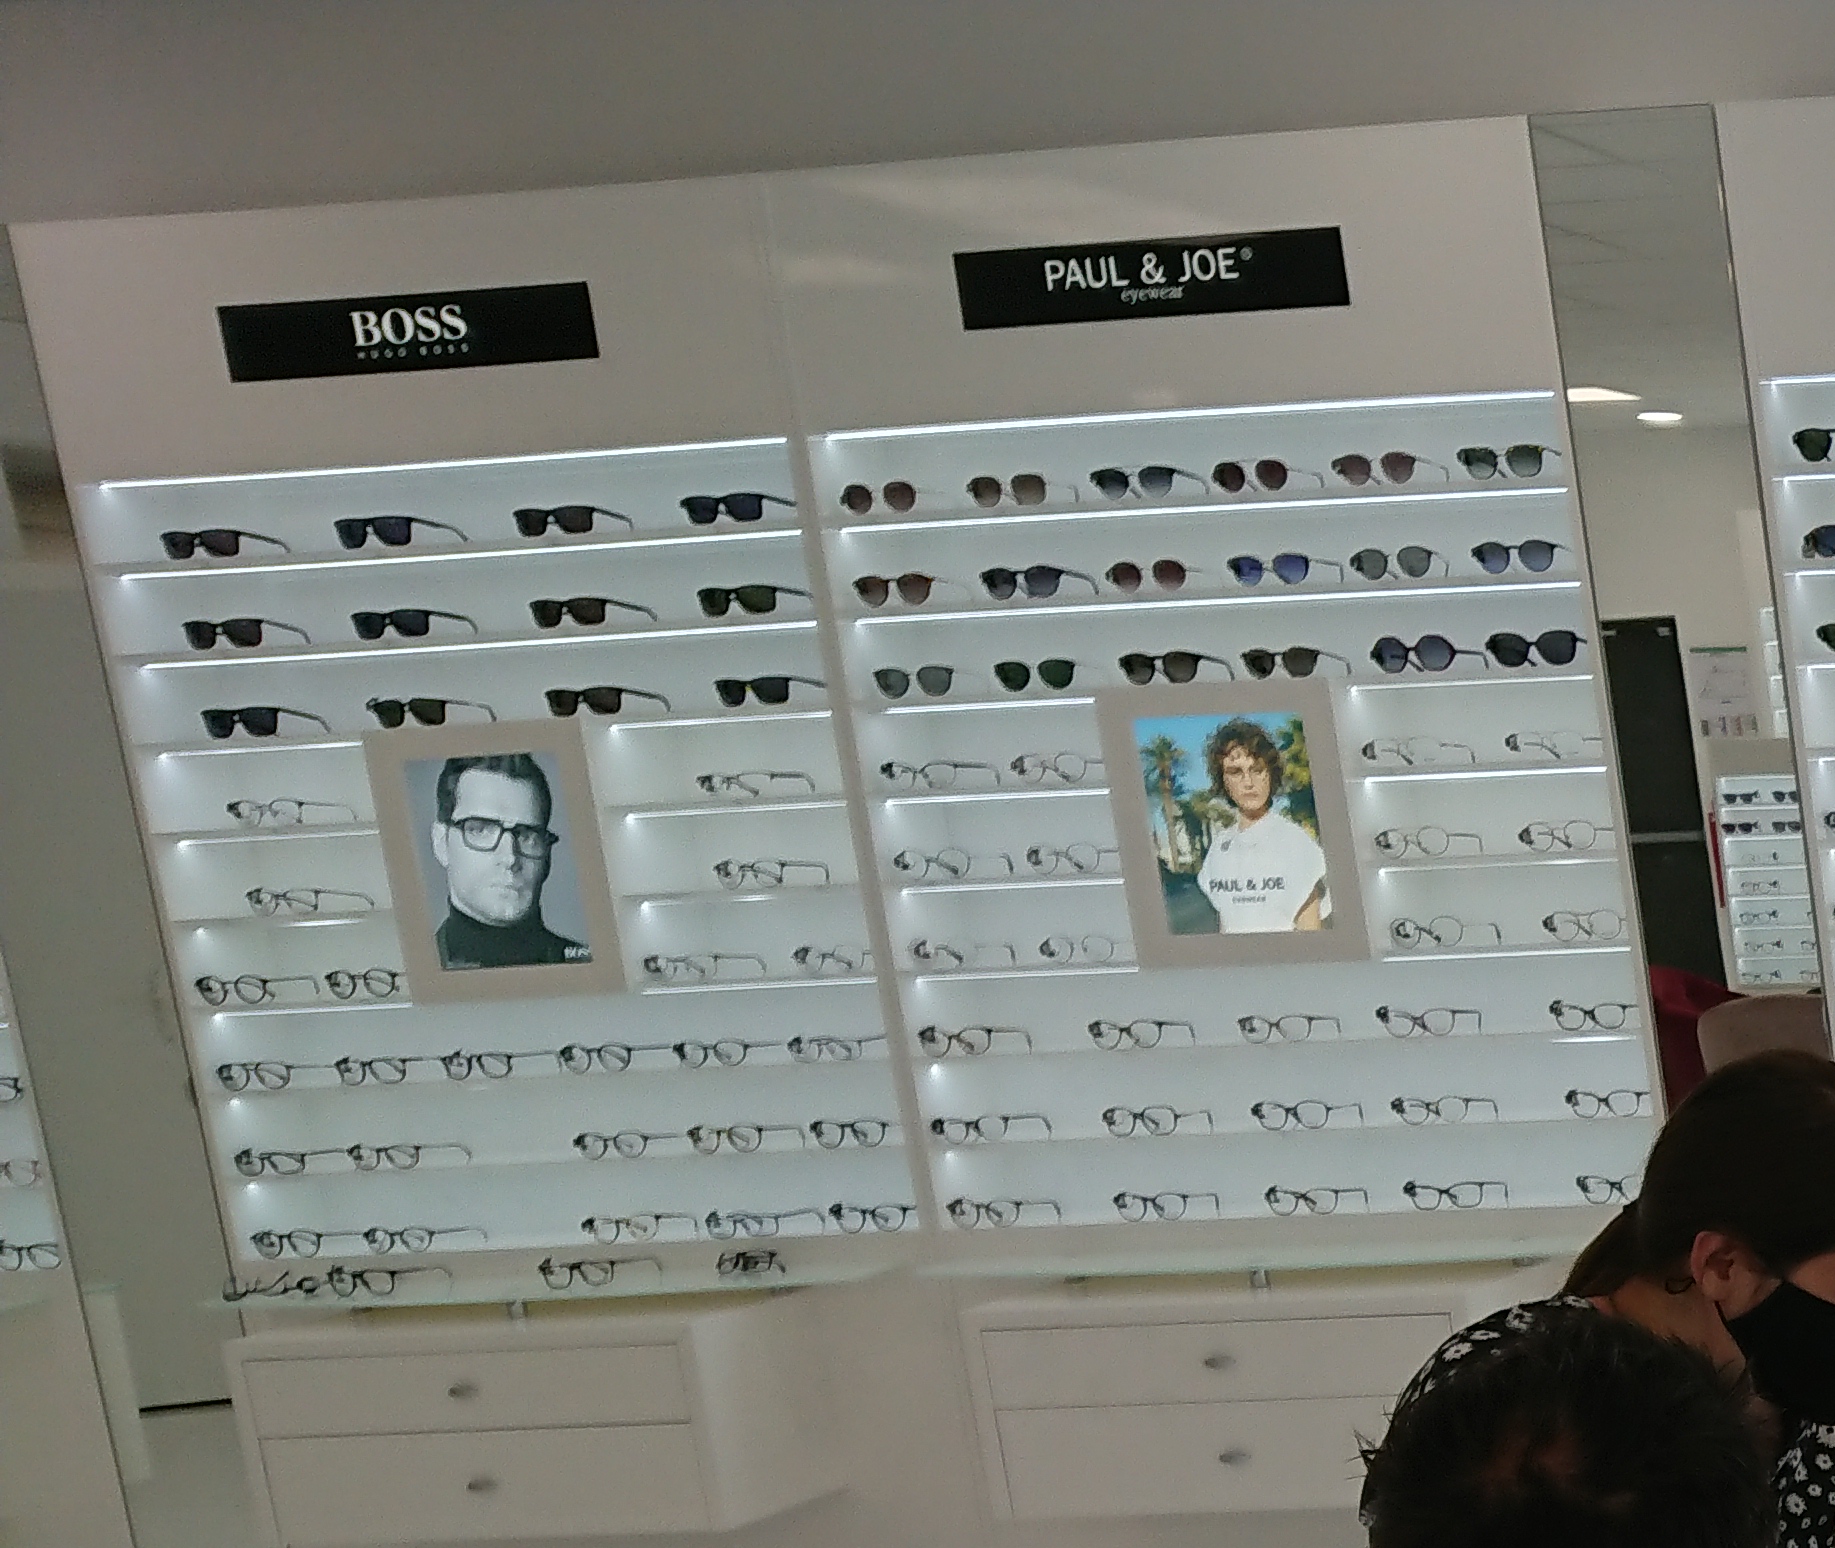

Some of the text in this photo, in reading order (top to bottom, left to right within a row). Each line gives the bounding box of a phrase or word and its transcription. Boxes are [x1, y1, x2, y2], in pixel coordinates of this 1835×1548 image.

[1044, 256, 1130, 291] PAUL
[1140, 252, 1167, 285] &
[1121, 285, 1185, 305] eyewear
[350, 305, 468, 347] BOSS
[1209, 876, 1285, 892] PAUL & JOE
